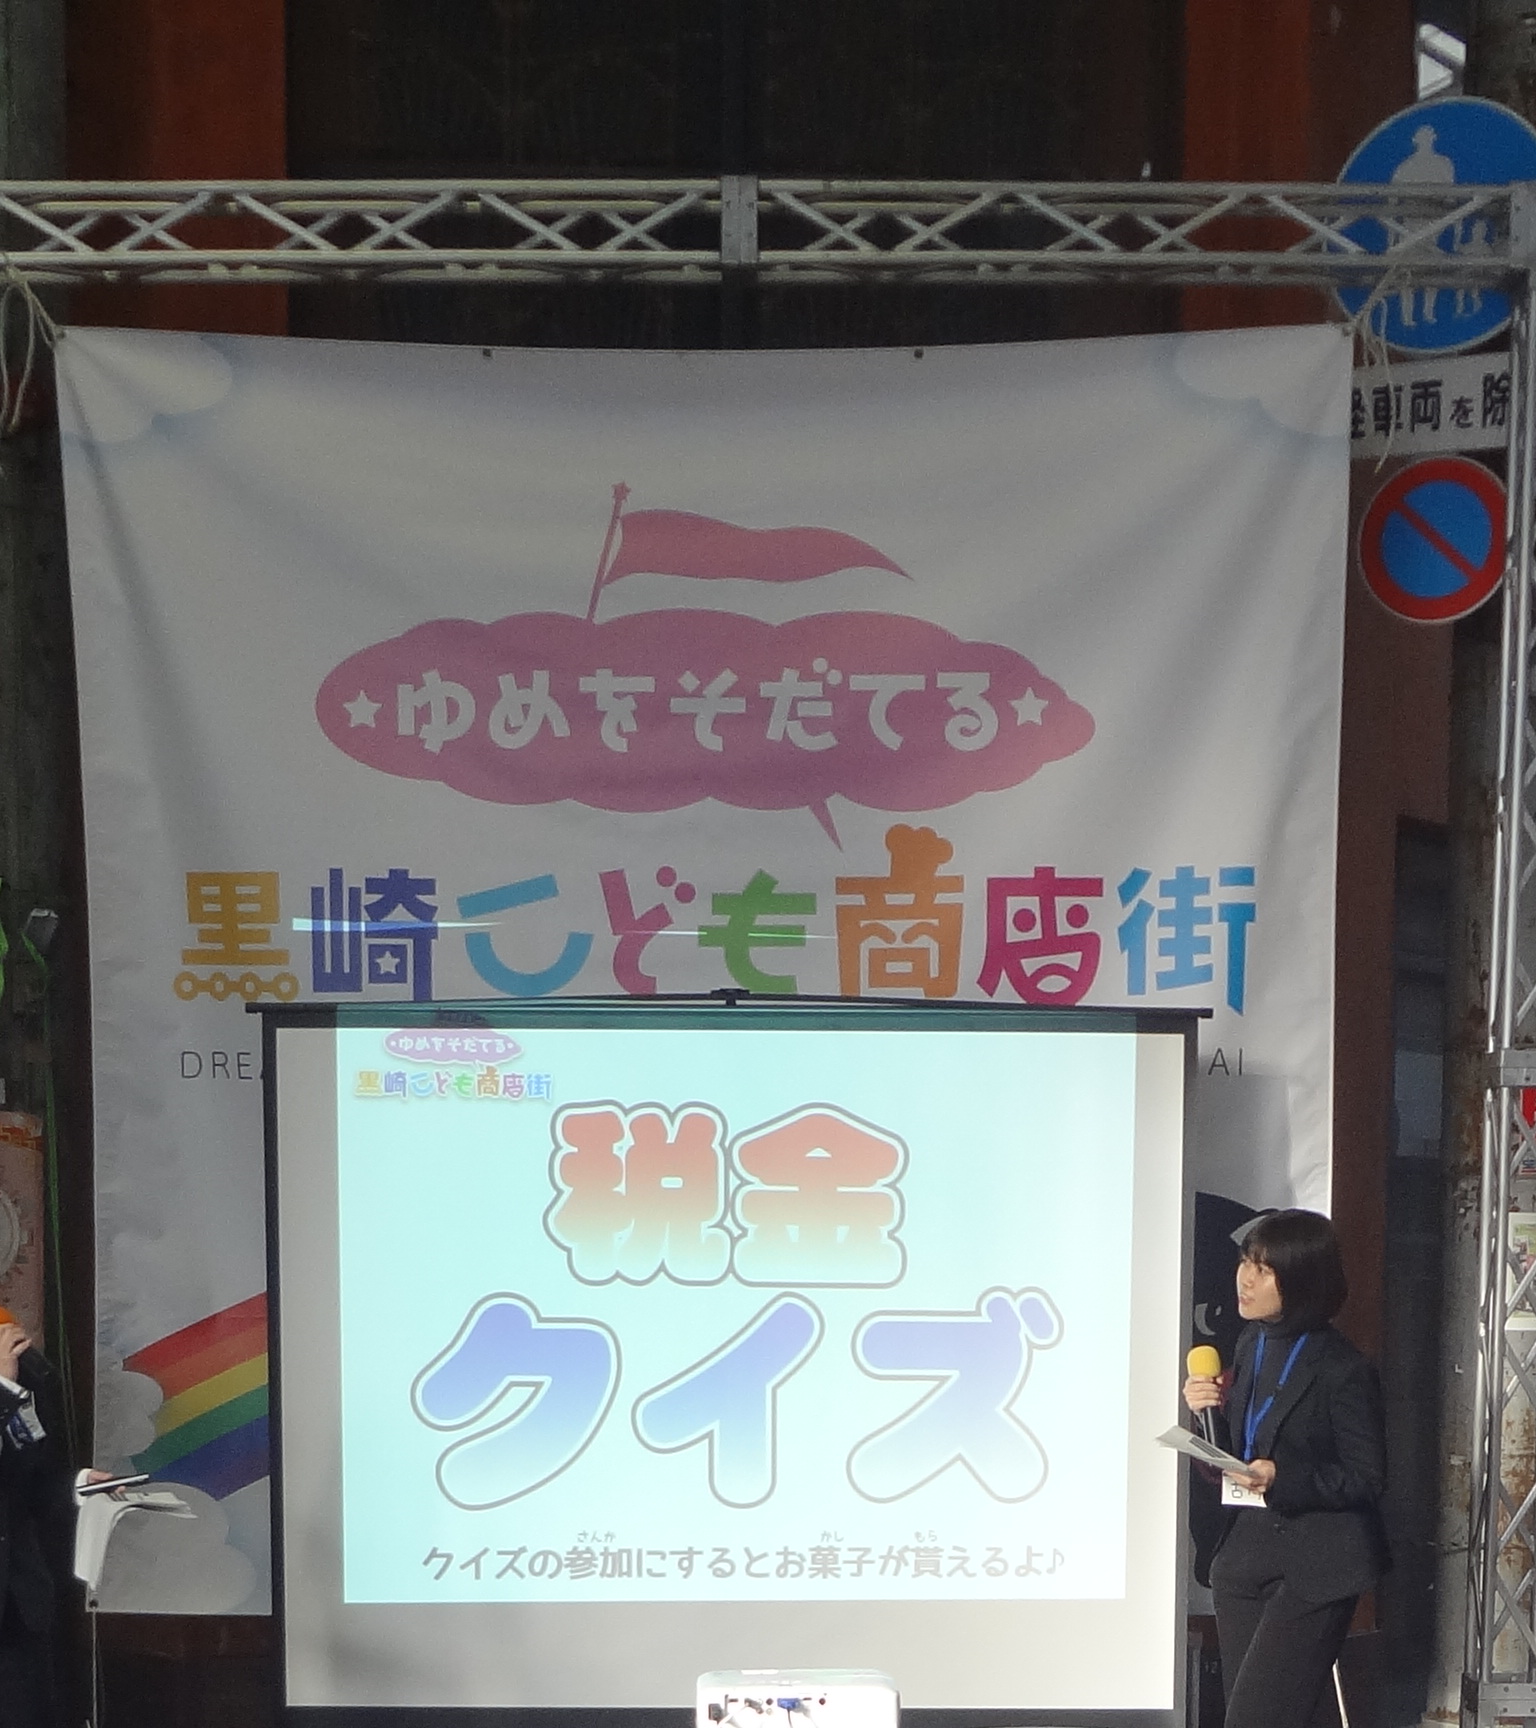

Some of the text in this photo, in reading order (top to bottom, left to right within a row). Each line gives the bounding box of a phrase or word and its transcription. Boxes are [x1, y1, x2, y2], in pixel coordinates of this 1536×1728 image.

[396, 657, 1001, 753] ゆめをそだてる
[173, 824, 1256, 1016] 黒崎こども商店街
[180, 1047, 1243, 1080] DRE AI
[357, 1066, 552, 1099] 黒崎こども商店街
[542, 1099, 911, 1288] 税金
[411, 1287, 1064, 1511] クイズ
[576, 1530, 617, 1544] さんか
[820, 1530, 845, 1543] かし
